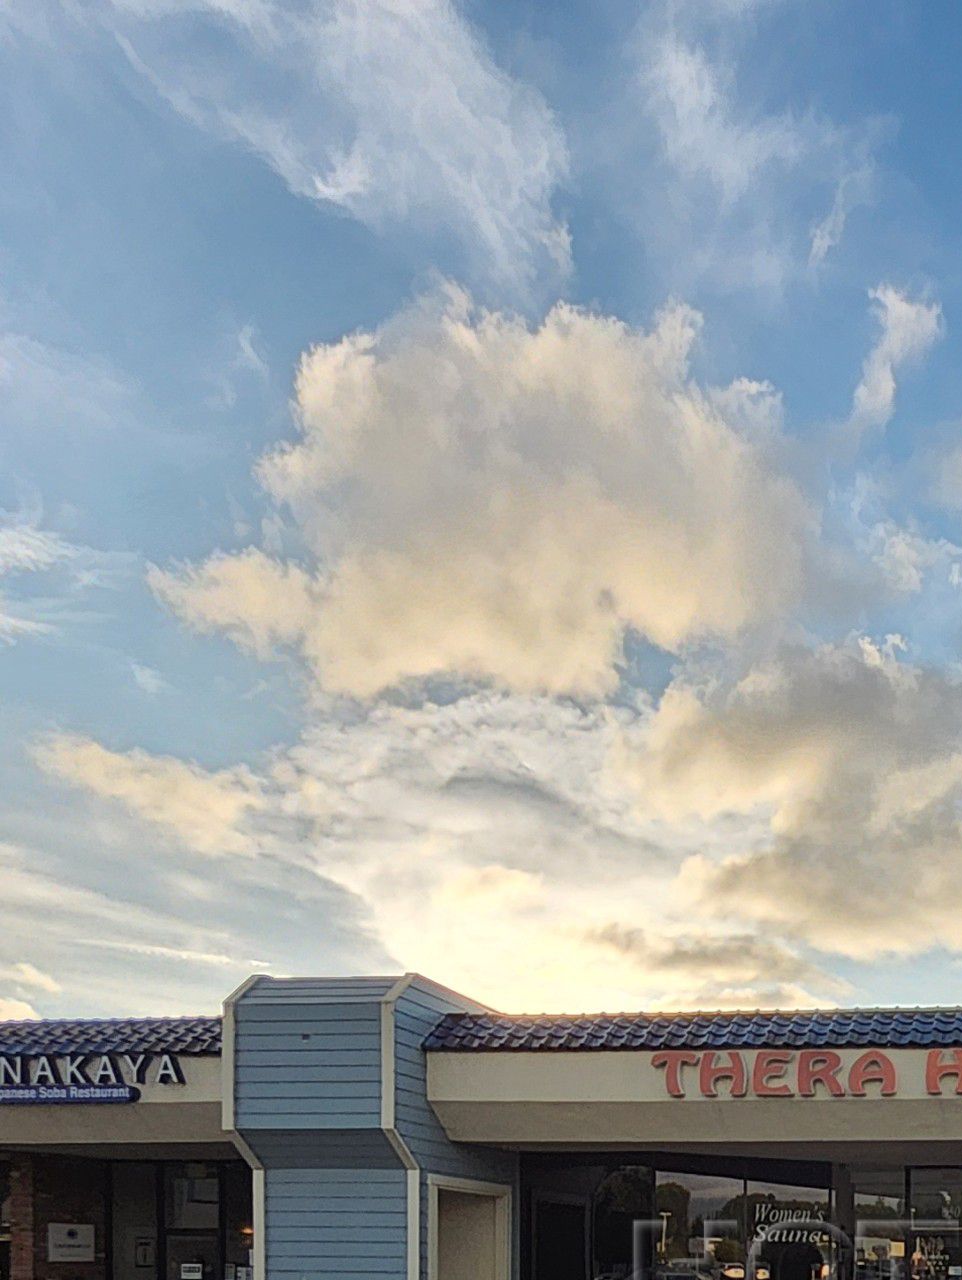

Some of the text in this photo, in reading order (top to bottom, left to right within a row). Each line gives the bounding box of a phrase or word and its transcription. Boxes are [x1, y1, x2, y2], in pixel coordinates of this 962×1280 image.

[651, 1050, 898, 1097] THERA
[38, 1086, 66, 1099] Soba
[69, 1086, 130, 1099] Restaurant
[754, 1203, 825, 1223] Women's
[753, 1223, 824, 1243] Sauna
